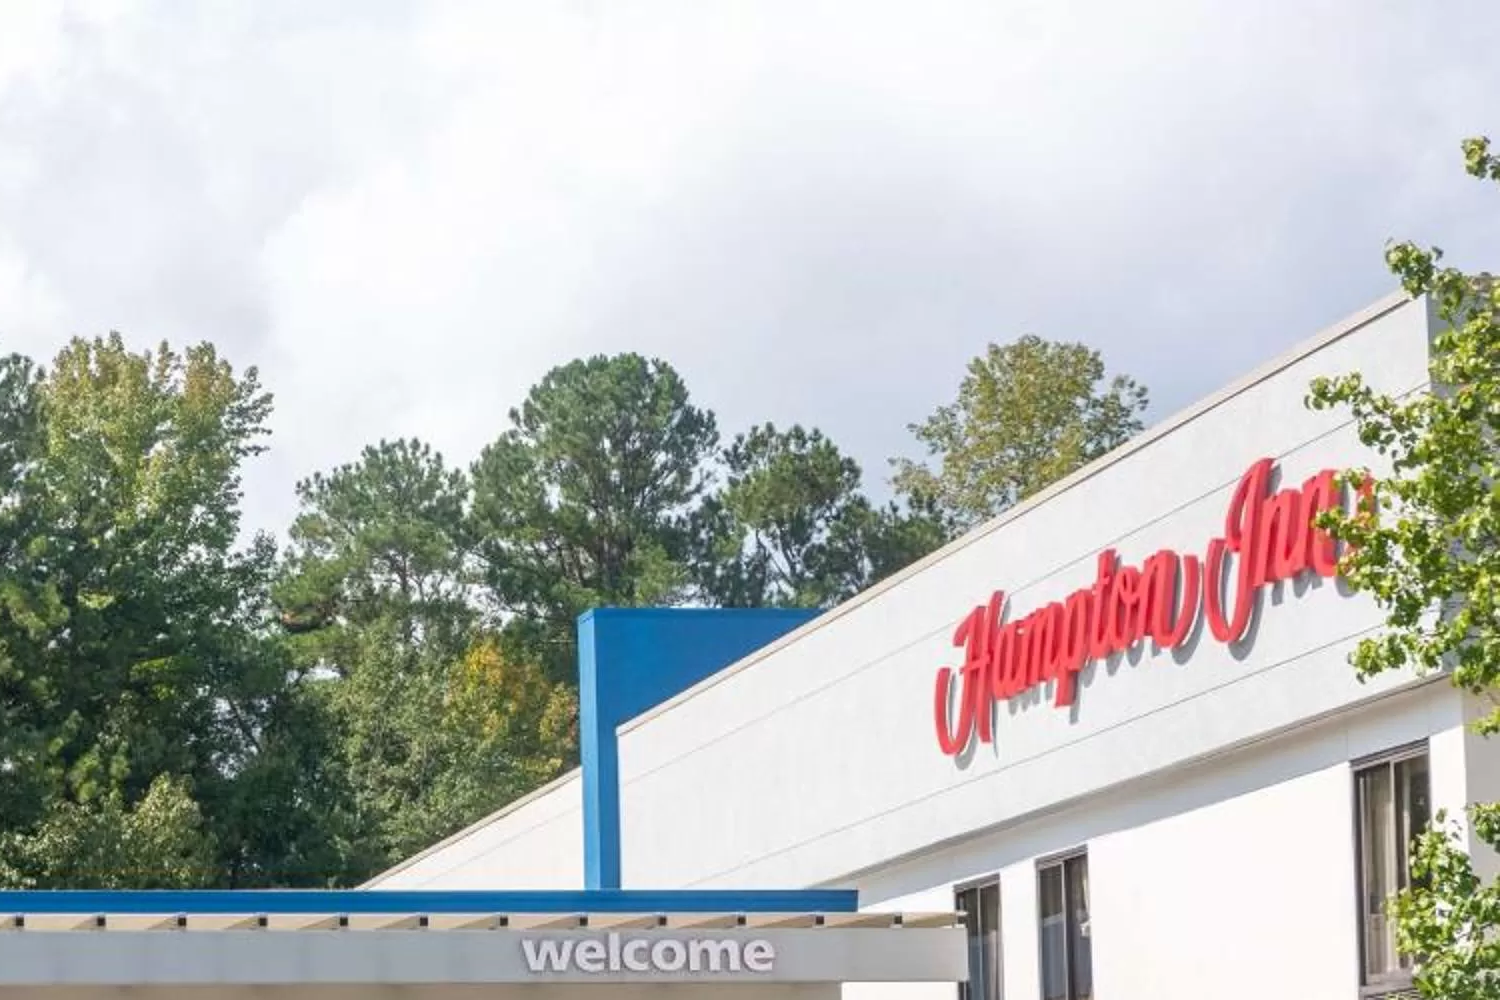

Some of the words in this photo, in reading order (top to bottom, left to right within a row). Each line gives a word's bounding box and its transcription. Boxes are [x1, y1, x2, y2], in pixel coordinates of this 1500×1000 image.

[933, 547, 1202, 756] Hampton
[1203, 457, 1376, 643] Inn
[520, 931, 776, 973] welcome
